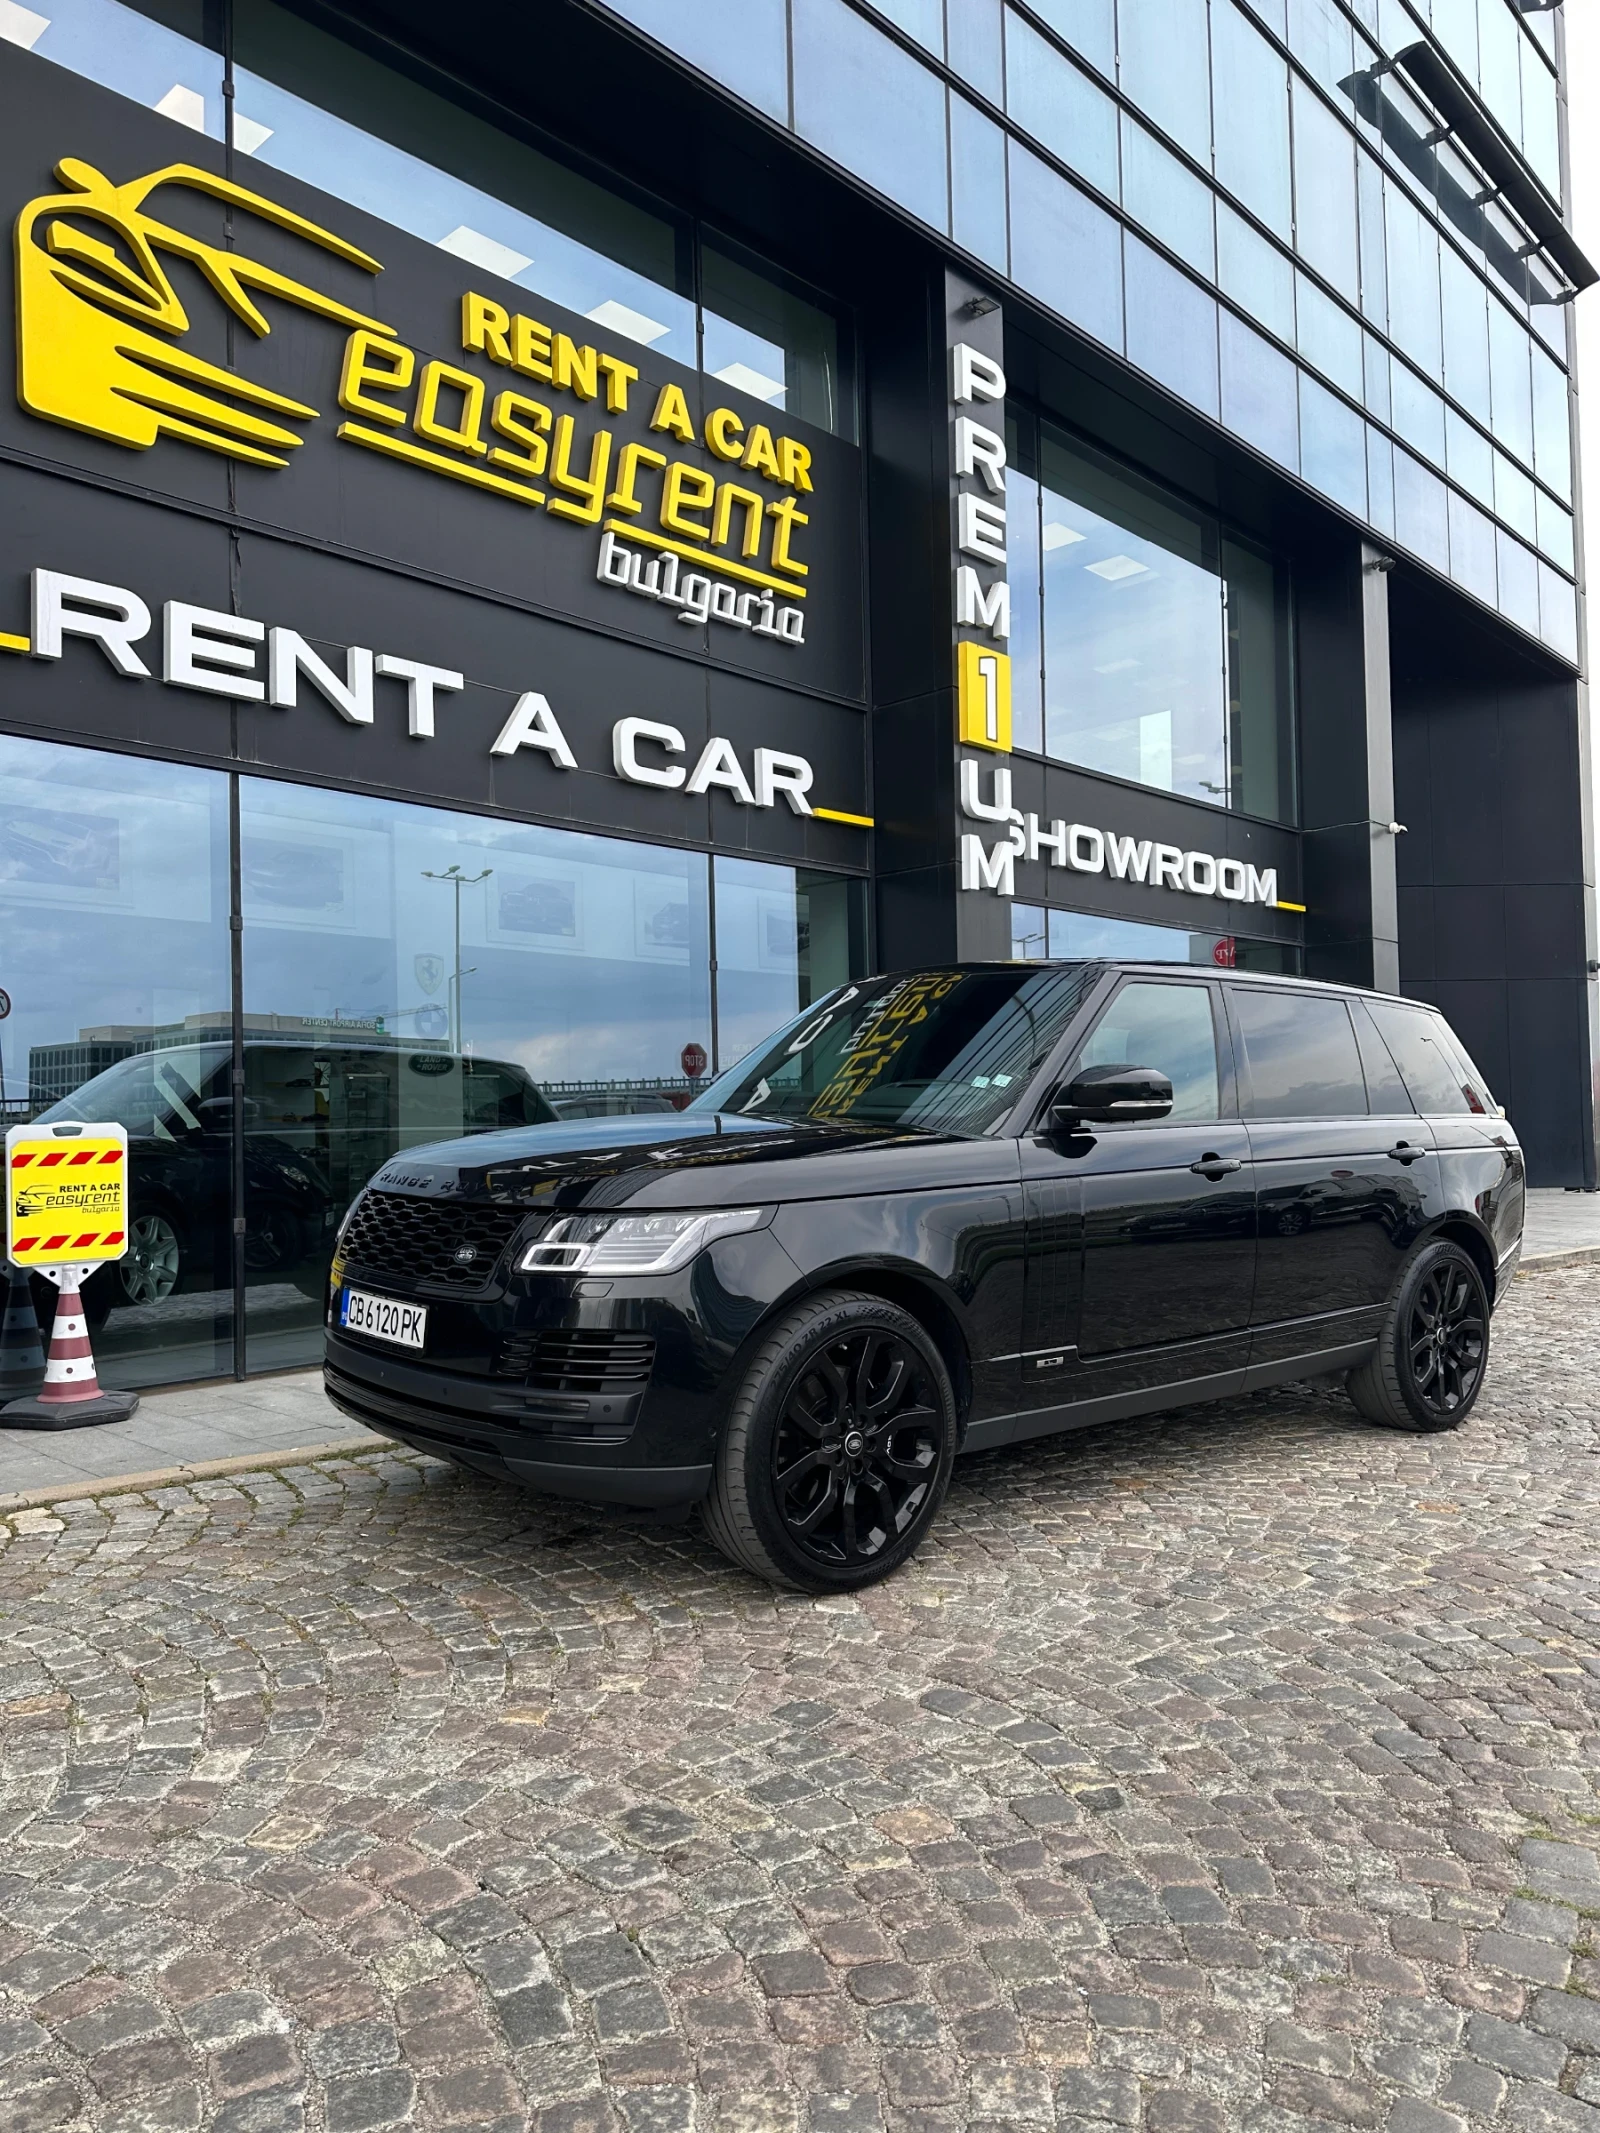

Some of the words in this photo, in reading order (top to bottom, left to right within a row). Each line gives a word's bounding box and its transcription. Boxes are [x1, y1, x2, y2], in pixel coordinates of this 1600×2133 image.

[462, 291, 638, 414] RENT
[650, 384, 695, 443] A
[705, 407, 813, 494] CAR
[338, 329, 808, 576] easyrent
[597, 532, 805, 645] bulgaria
[30, 567, 464, 739] RENT
[490, 691, 578, 769] A
[612, 716, 813, 816] CAR
[1008, 808, 1277, 907] SHOWROOM
[46, 1191, 120, 1206] easyrent
[59, 1184, 87, 1193] RENT
[82, 1205, 120, 1214] bulgaria
[379, 1172, 433, 1189] RANGE
